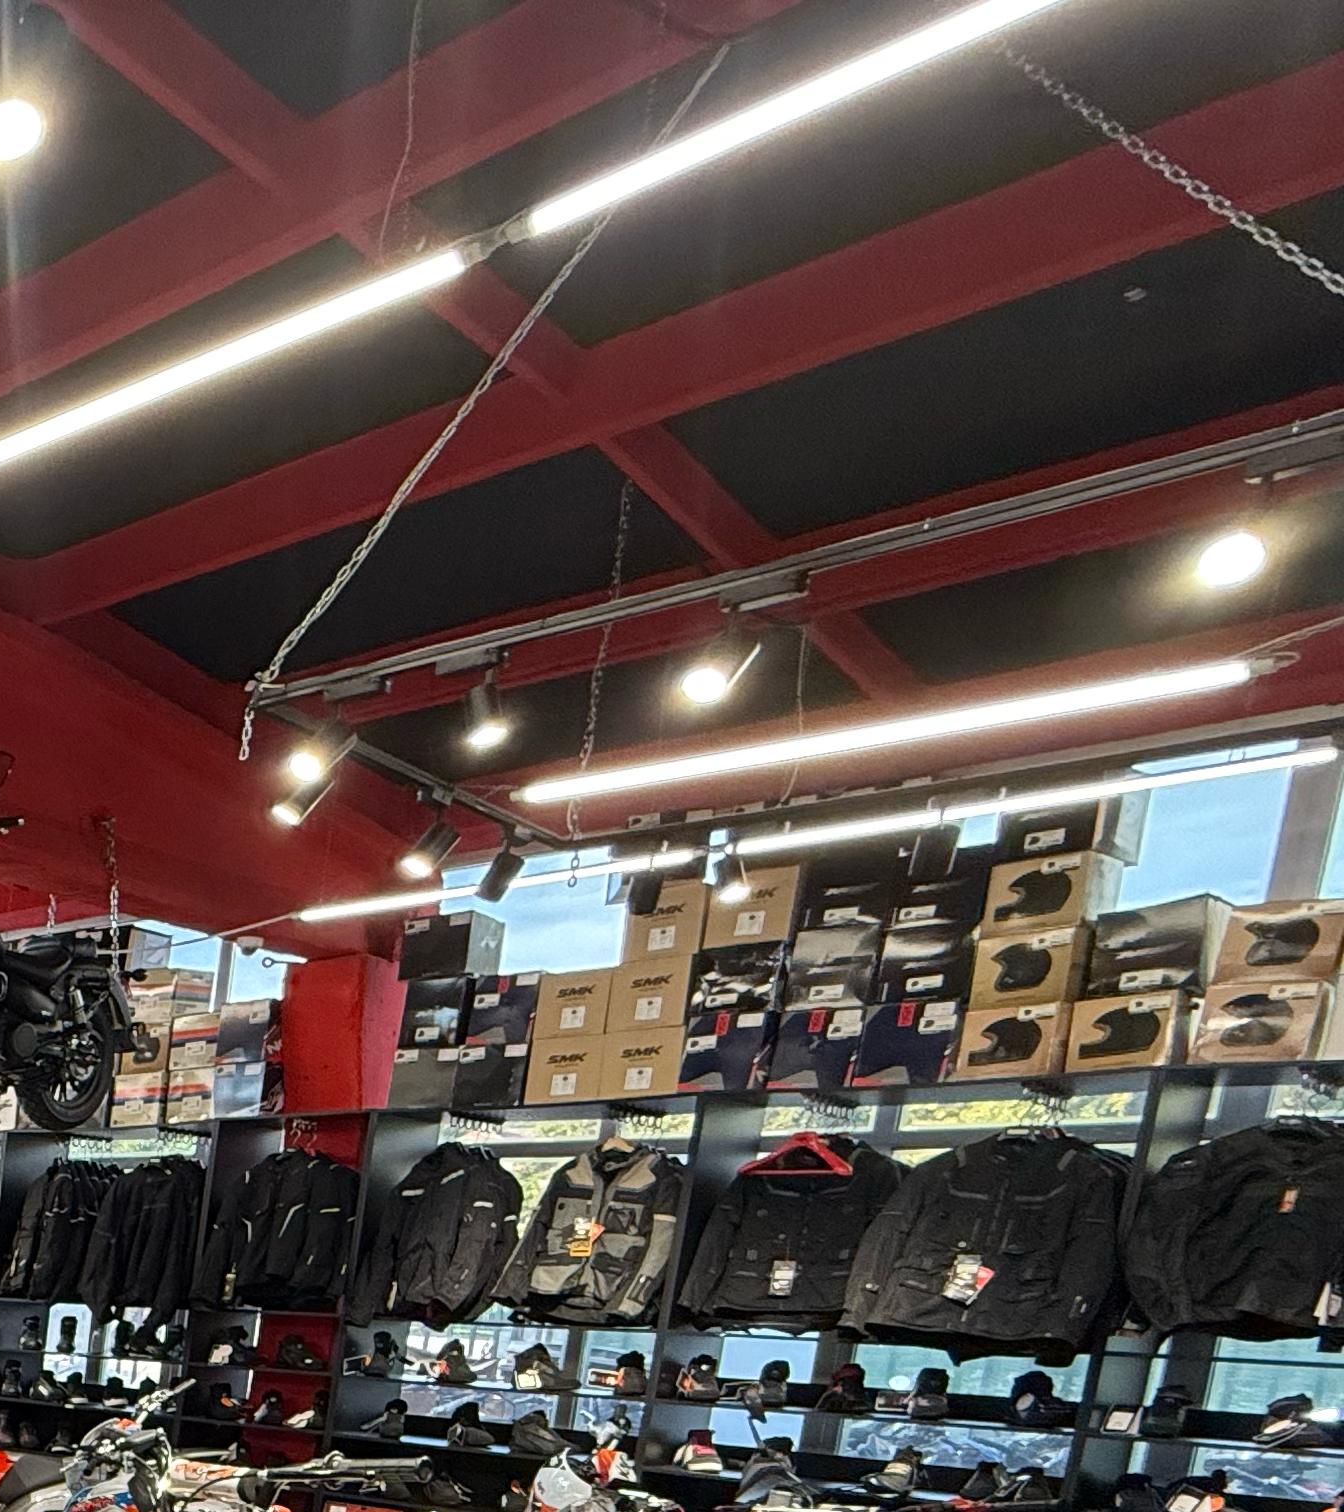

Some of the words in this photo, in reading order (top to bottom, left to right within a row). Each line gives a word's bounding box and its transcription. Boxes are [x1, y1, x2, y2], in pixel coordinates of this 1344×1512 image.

[630, 973, 674, 989] SMK
[556, 983, 597, 999] SMK
[546, 1052, 587, 1065] SMK
[620, 1045, 663, 1059] SMK
